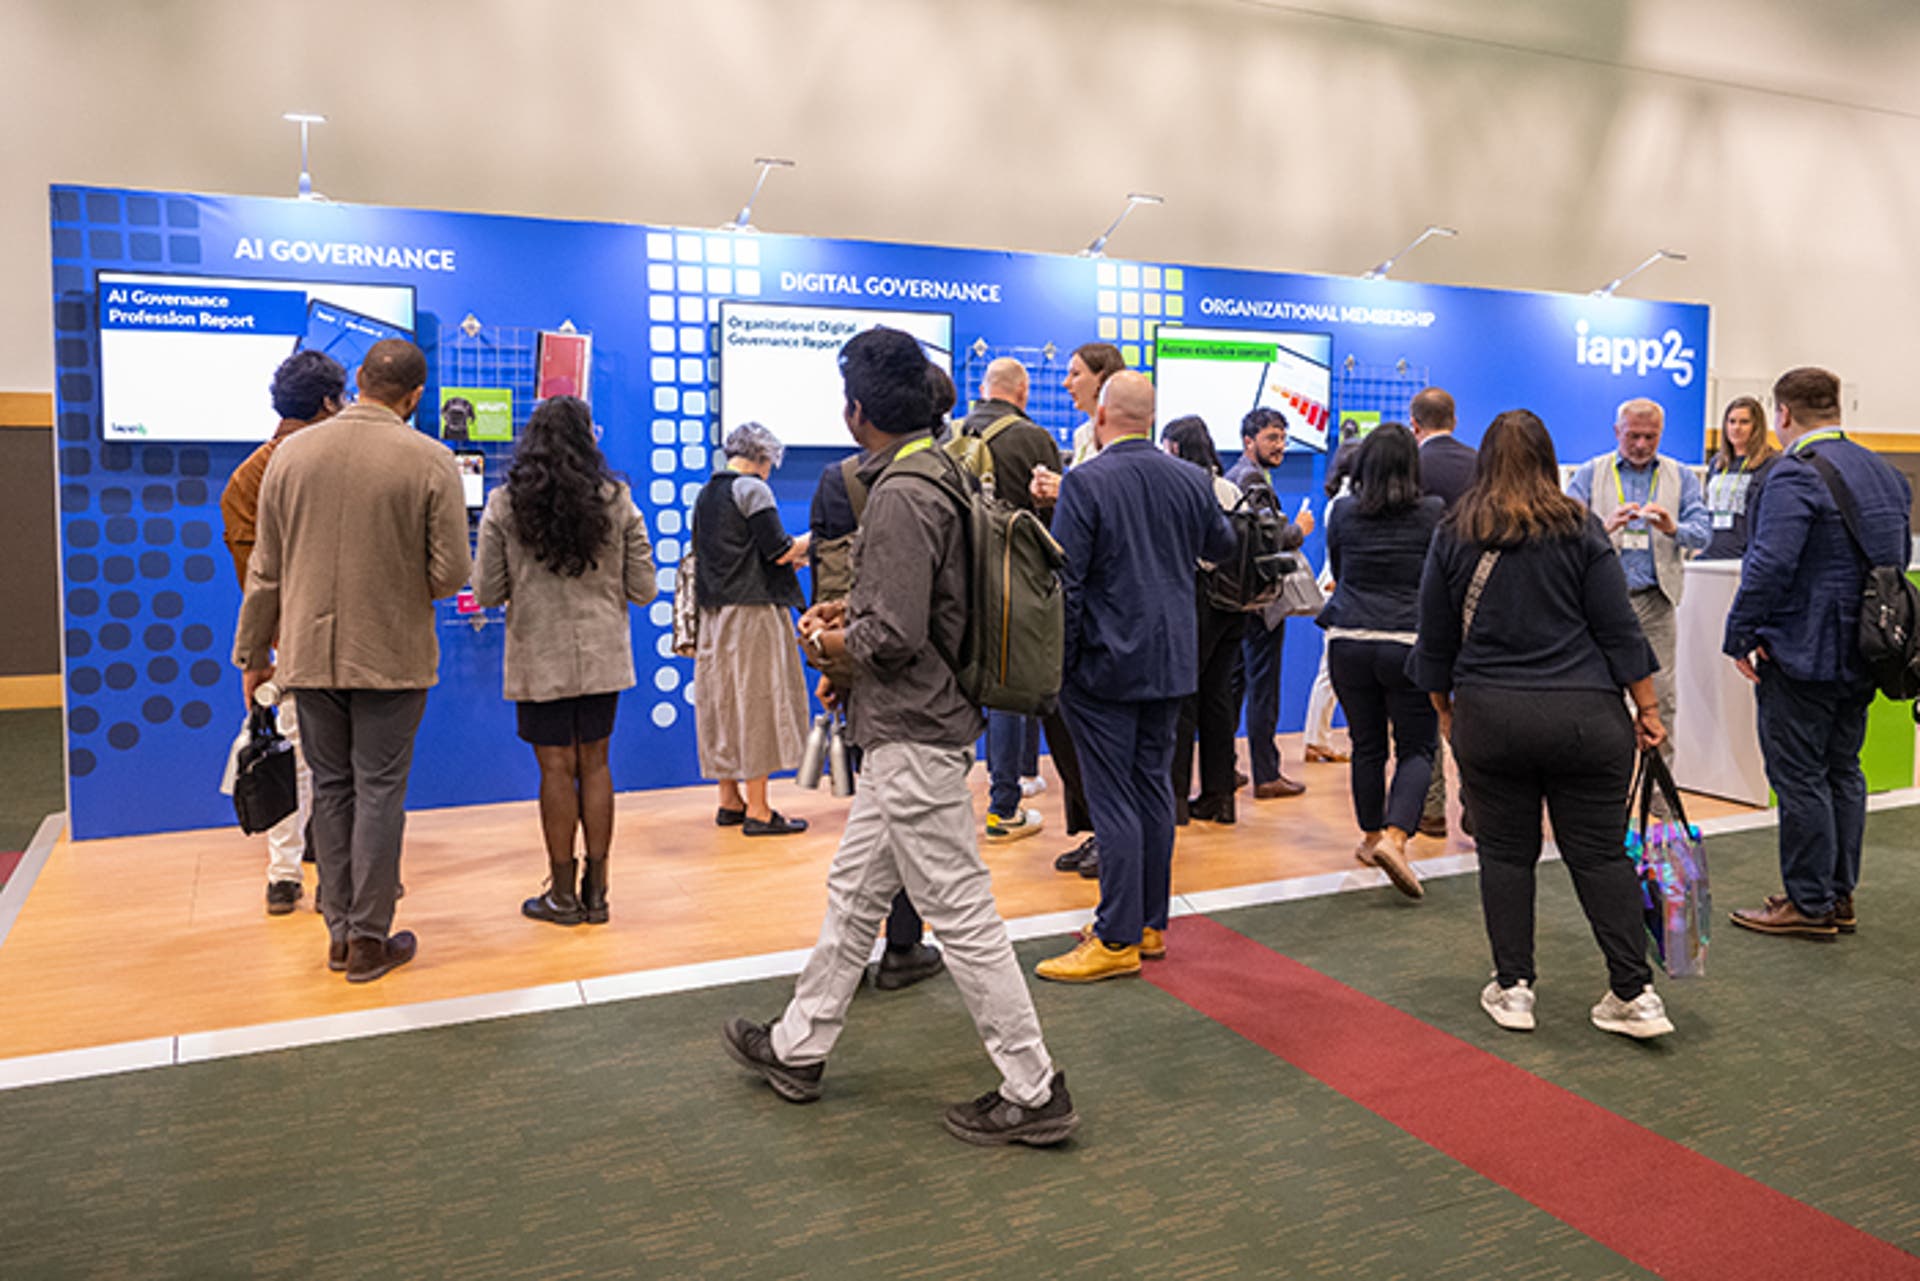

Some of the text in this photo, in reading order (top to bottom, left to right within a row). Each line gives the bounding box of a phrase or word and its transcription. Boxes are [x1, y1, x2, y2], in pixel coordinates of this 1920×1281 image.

[234, 238, 456, 271] AI GOVERNANCE
[780, 271, 1002, 303] DIGITAL GOVERNANCE
[108, 289, 230, 308] AI Governance
[109, 308, 256, 330] Profession Report
[1199, 297, 1437, 327] ORGANIZATIONAL MEMBERSHIP
[728, 315, 858, 335] Organizational Digital
[727, 332, 842, 351] Governance Report
